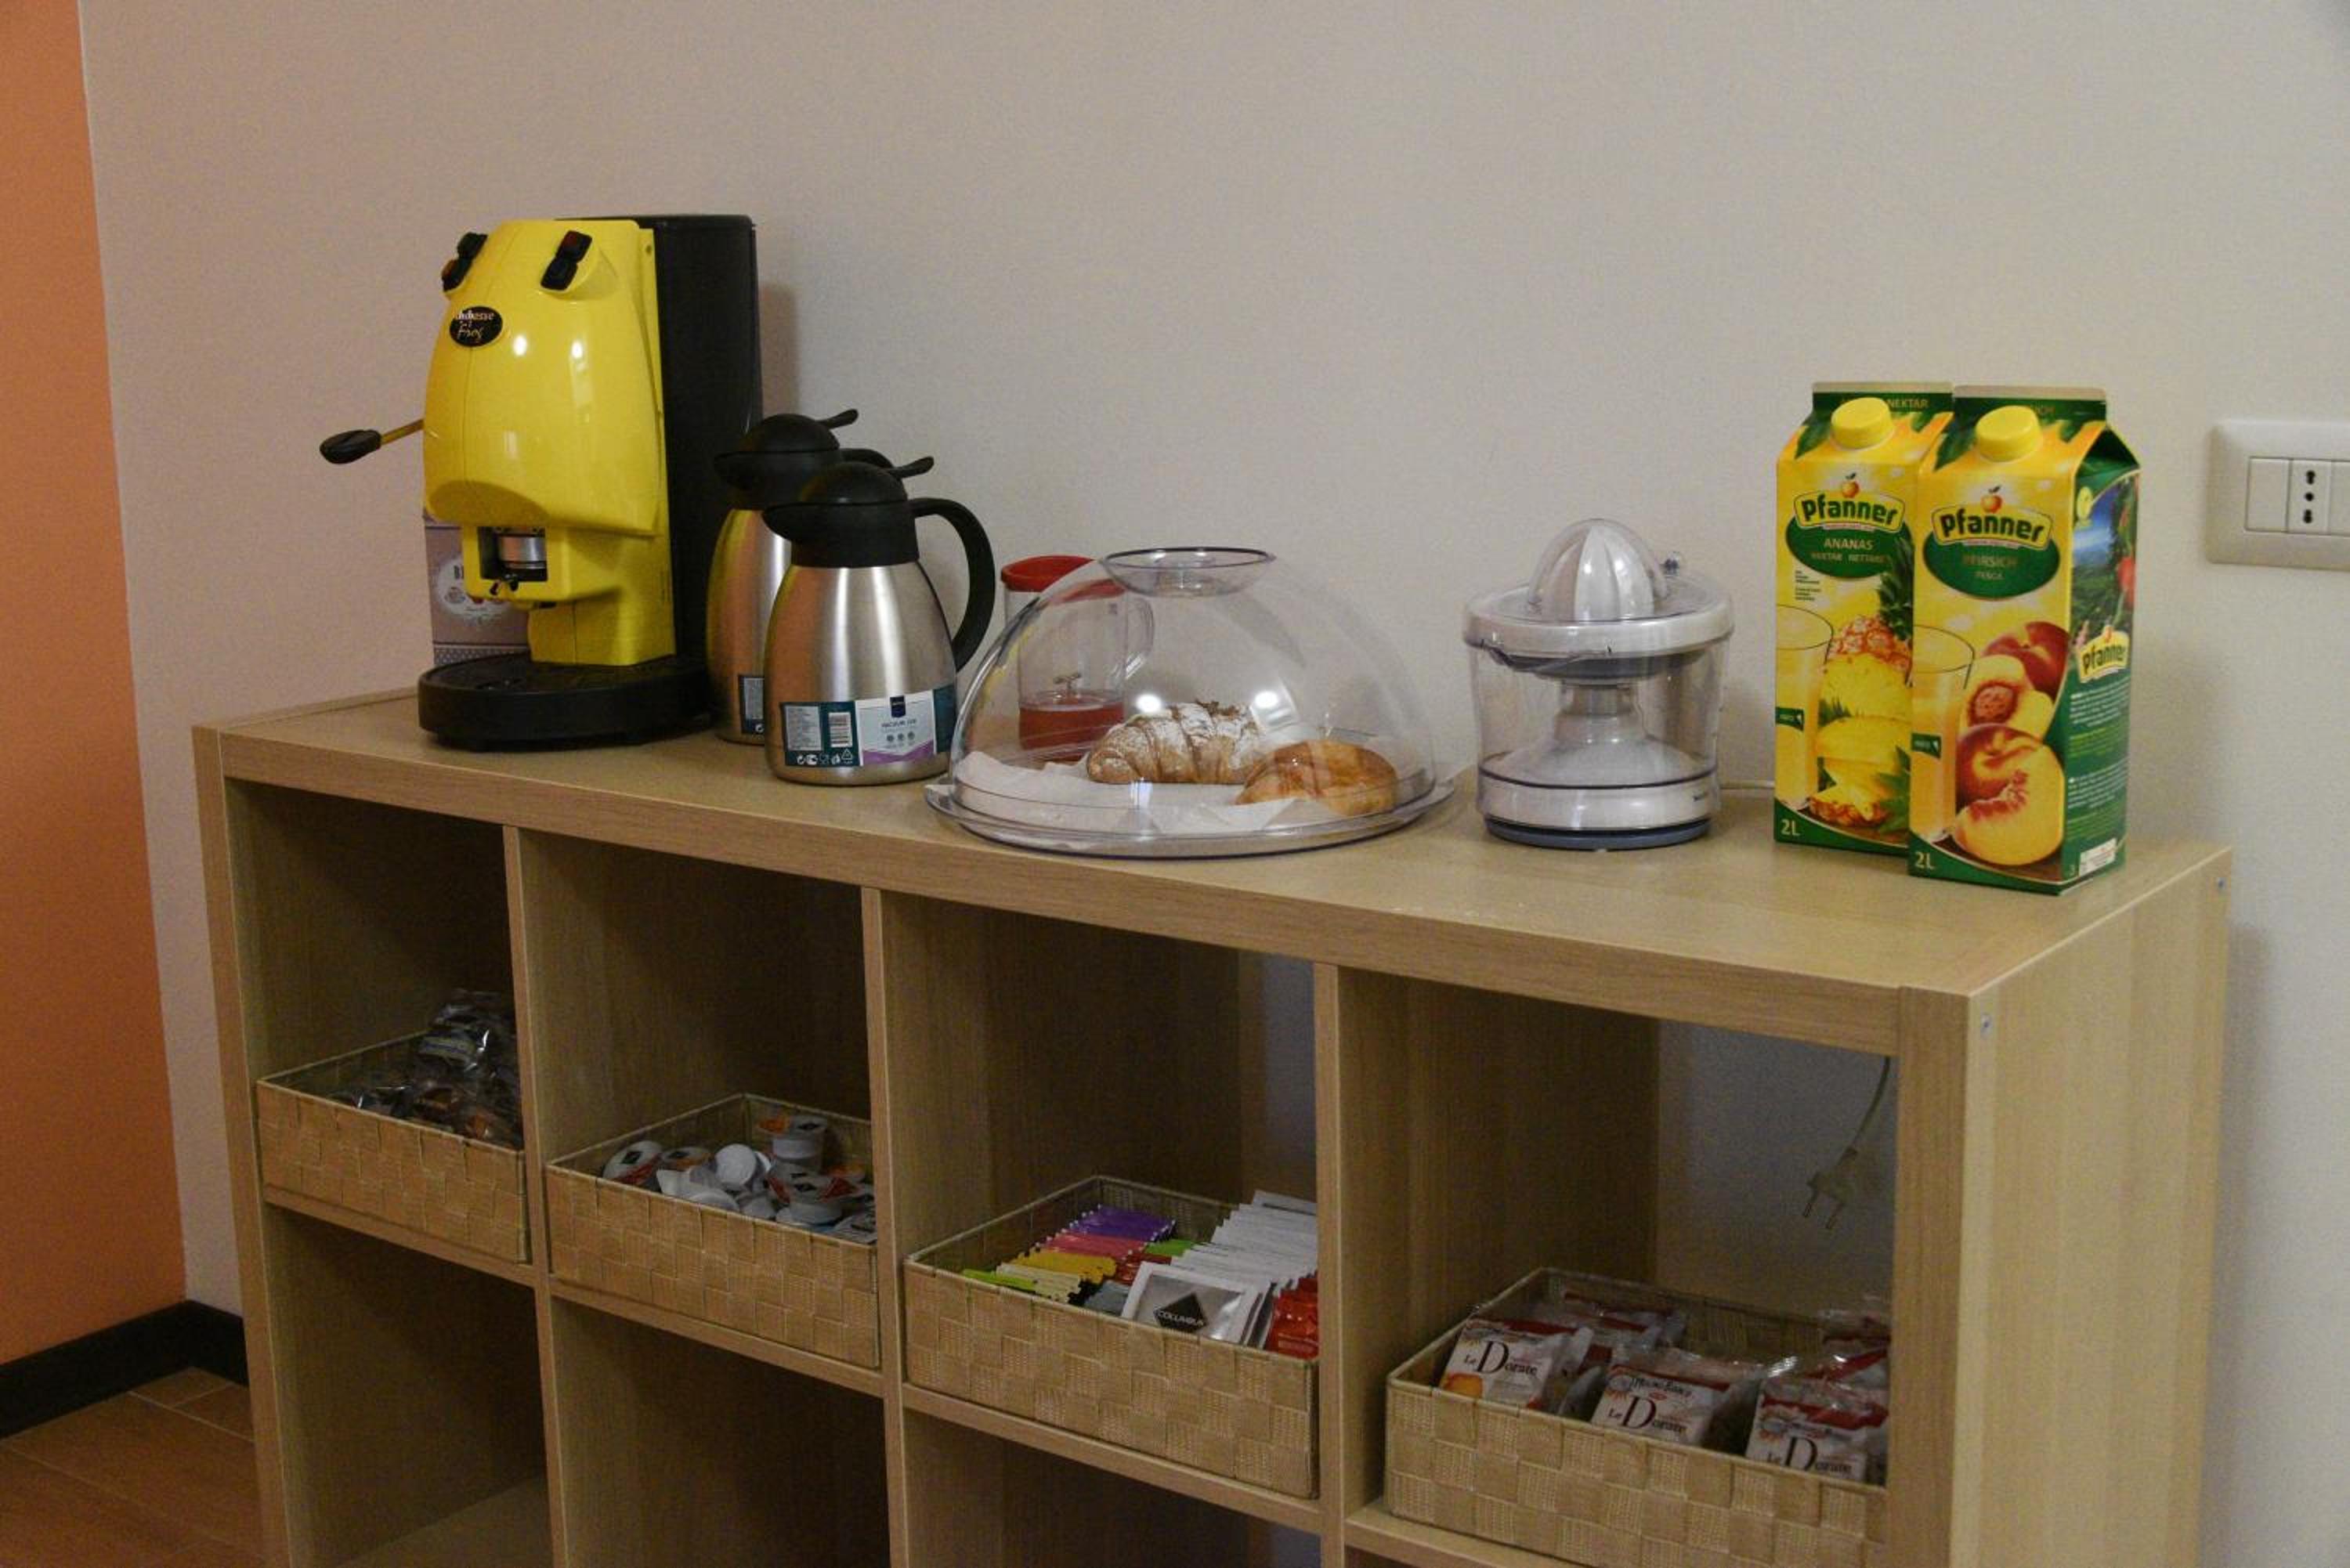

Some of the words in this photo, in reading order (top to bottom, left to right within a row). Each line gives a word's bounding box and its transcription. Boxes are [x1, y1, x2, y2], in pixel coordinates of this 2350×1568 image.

[1824, 538, 1875, 551] ANANAS
[1781, 819, 1800, 836] 2L
[1915, 852, 1936, 869] 2L
